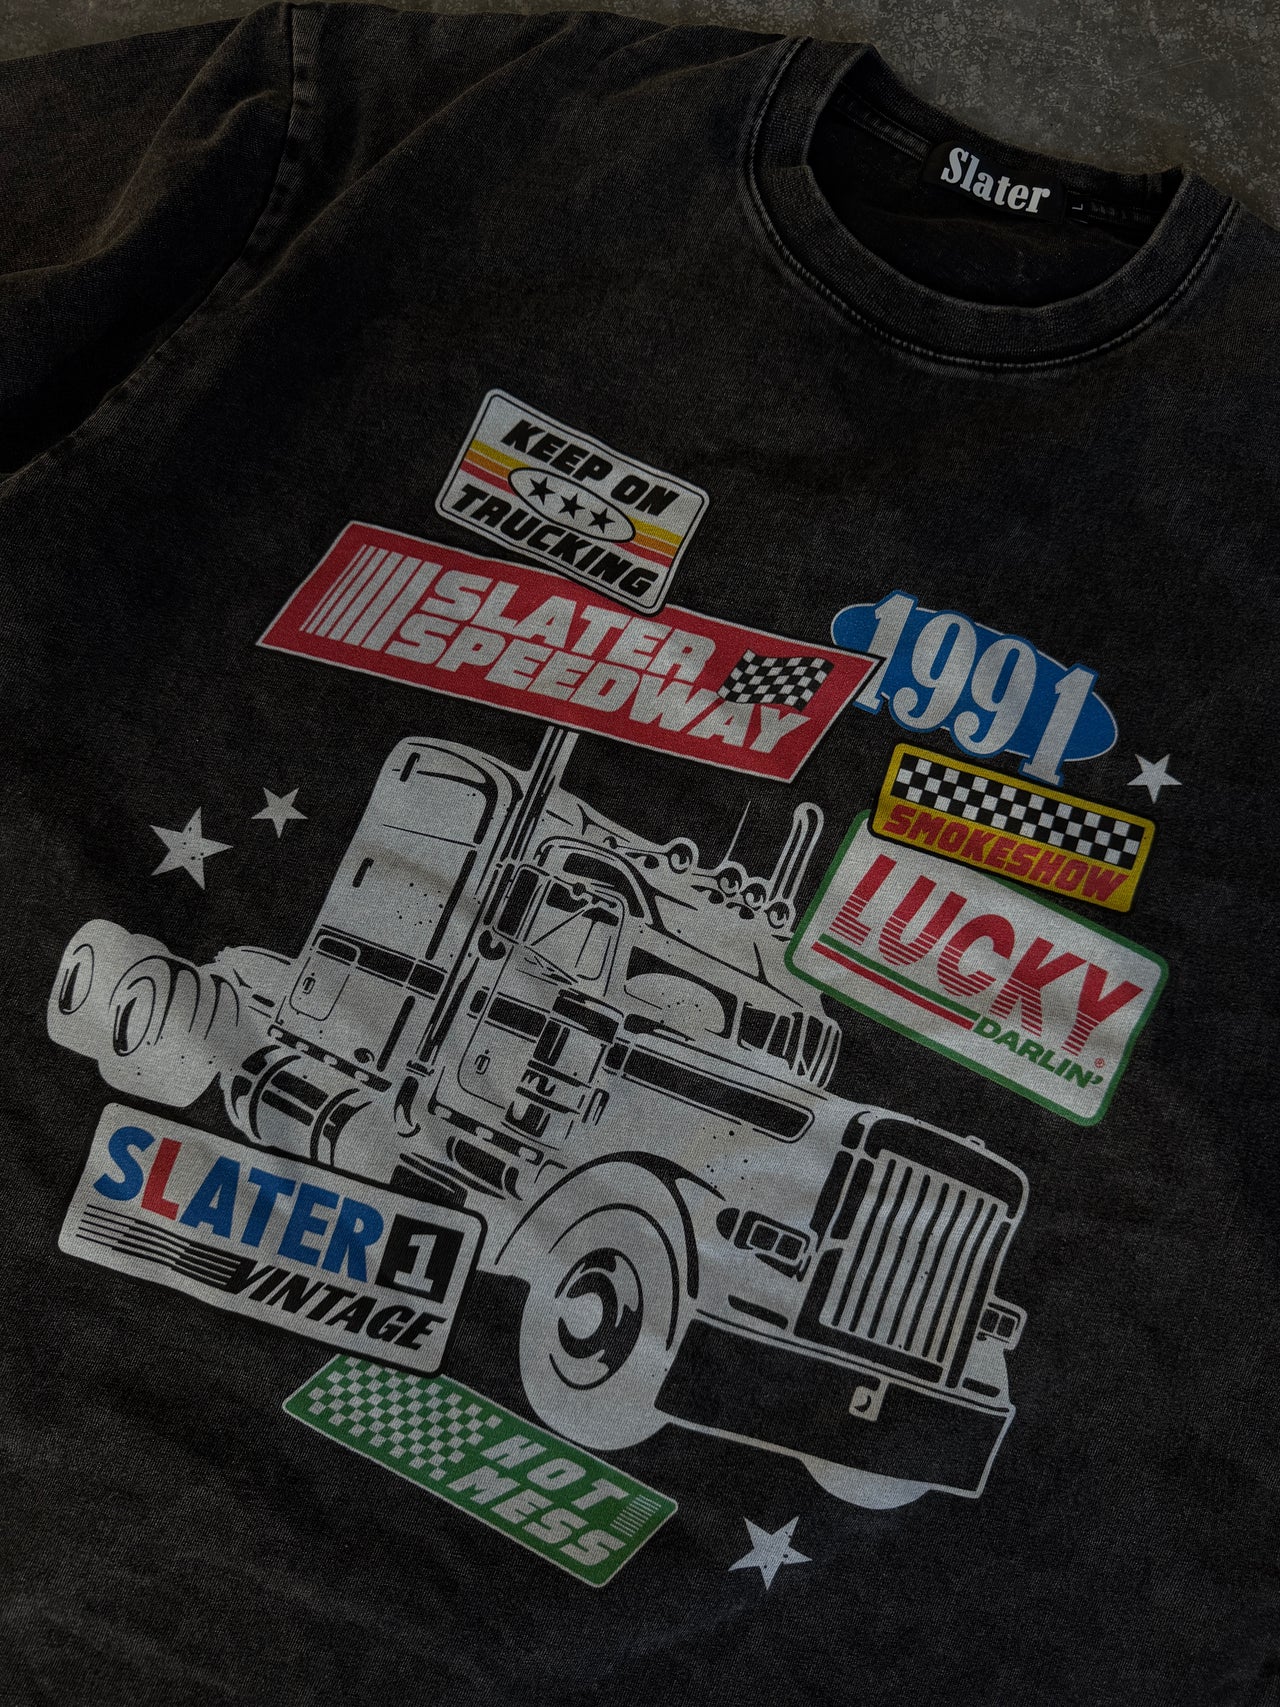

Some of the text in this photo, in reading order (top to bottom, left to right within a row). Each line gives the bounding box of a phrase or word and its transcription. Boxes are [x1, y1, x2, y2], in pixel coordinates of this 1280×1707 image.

[940, 147, 1051, 214] Slater
[501, 419, 680, 516] KEEP ON
[451, 484, 659, 597] TRUCKING
[421, 569, 716, 681] SLATER
[385, 614, 811, 754] SPEEDWAY
[856, 593, 1095, 786] 1991
[883, 804, 1129, 902] SMOKESHOW
[829, 853, 1143, 1057] LUCKY
[972, 1013, 1104, 1089] DARLIN'
[93, 1126, 438, 1293] SLATER 1
[225, 1259, 447, 1351] VINTAGE
[446, 1465, 627, 1566] MESS
[480, 1434, 629, 1510] HOT
